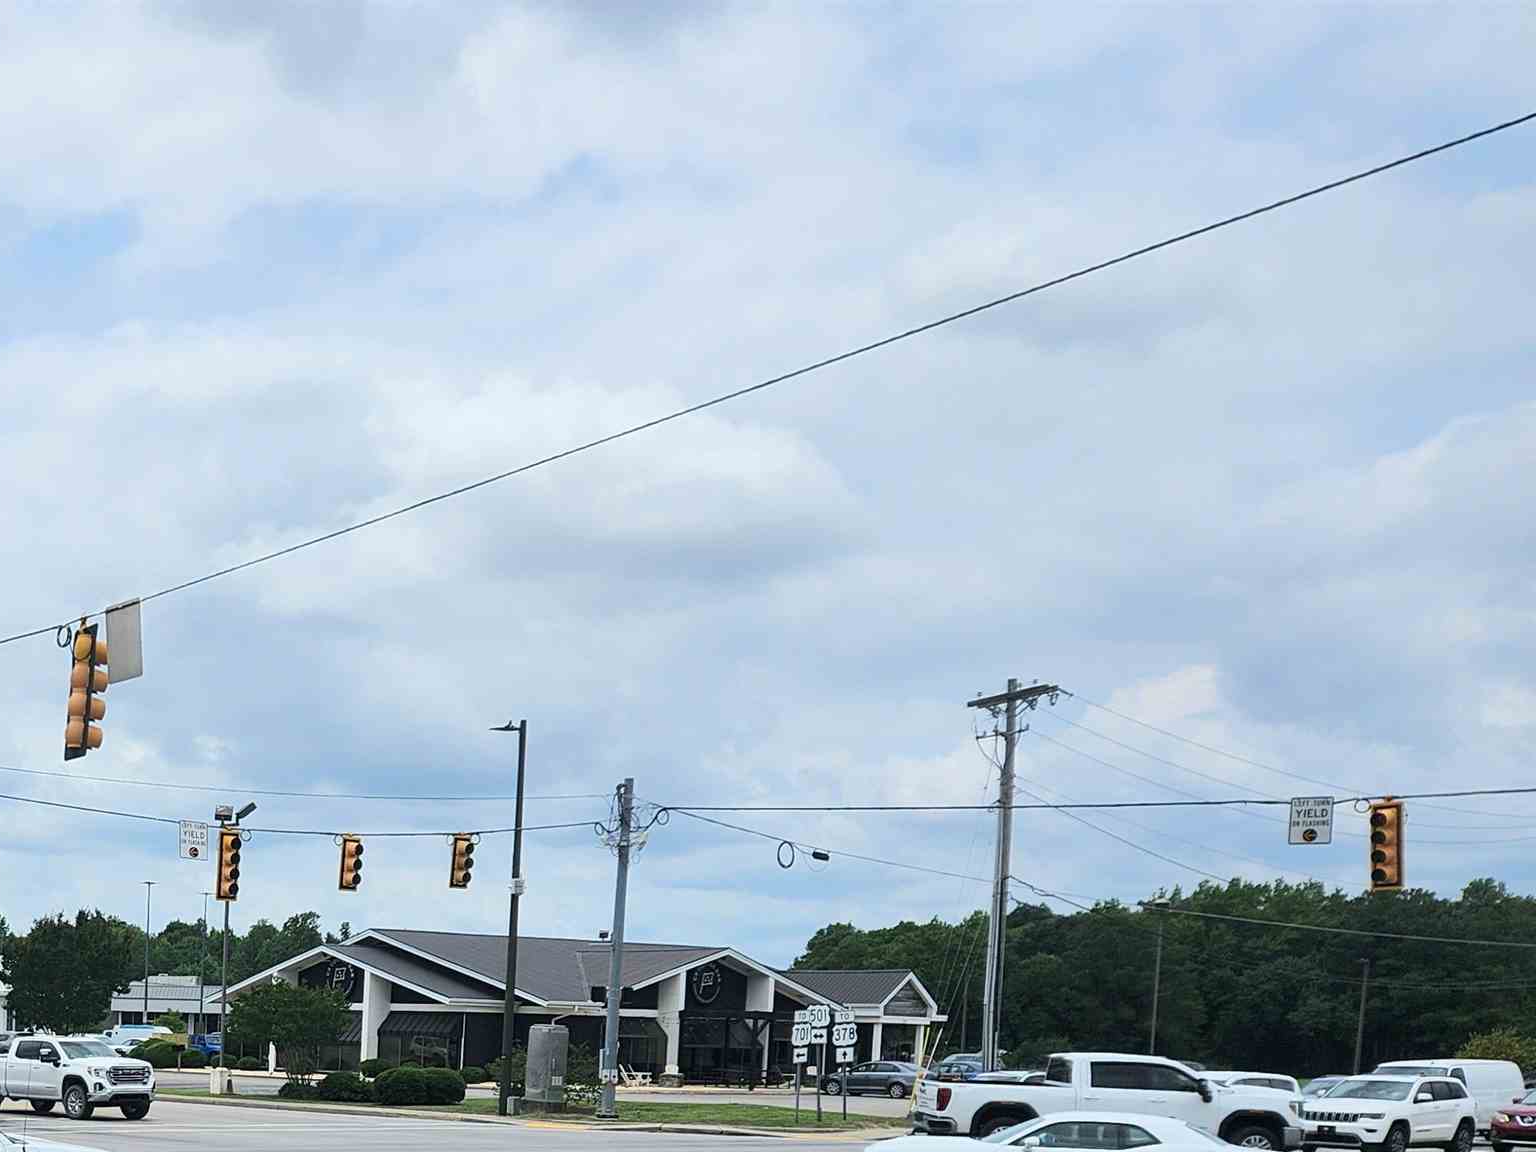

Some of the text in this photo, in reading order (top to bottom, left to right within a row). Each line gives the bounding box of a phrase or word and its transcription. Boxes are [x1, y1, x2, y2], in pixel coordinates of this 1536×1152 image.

[1296, 808, 1329, 818] YIELD
[183, 831, 206, 839] YIELD
[810, 1009, 827, 1022] 501
[794, 1028, 809, 1041] 701
[835, 1027, 855, 1041] 378
